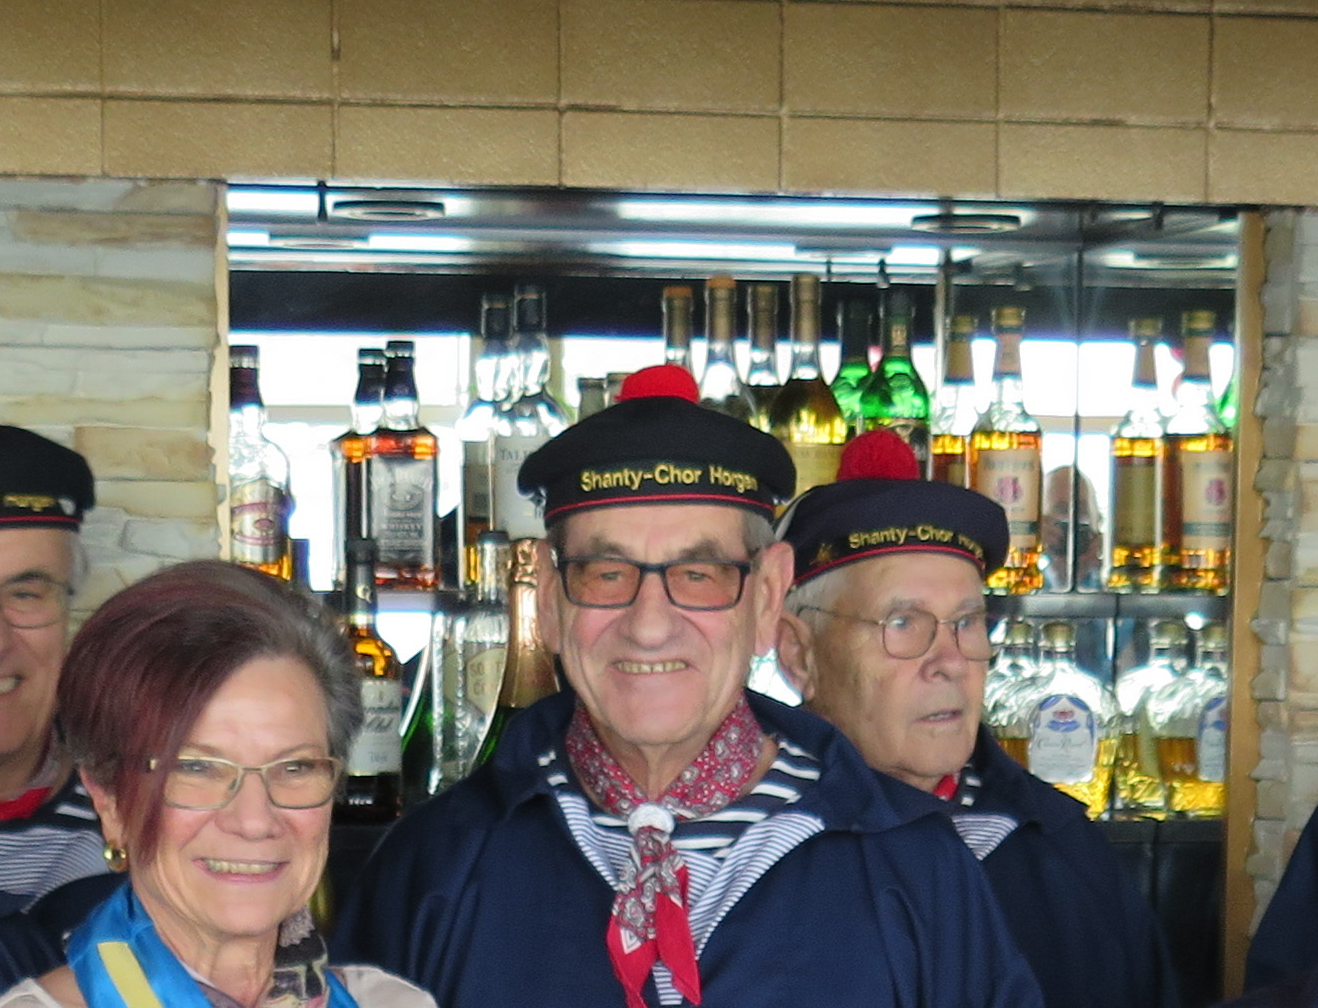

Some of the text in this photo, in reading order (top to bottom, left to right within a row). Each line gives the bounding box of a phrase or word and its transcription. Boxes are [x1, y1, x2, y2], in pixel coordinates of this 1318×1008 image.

[581, 464, 758, 493] Shanty-Chor Horgen
[848, 525, 953, 549] Shanty-Chor
